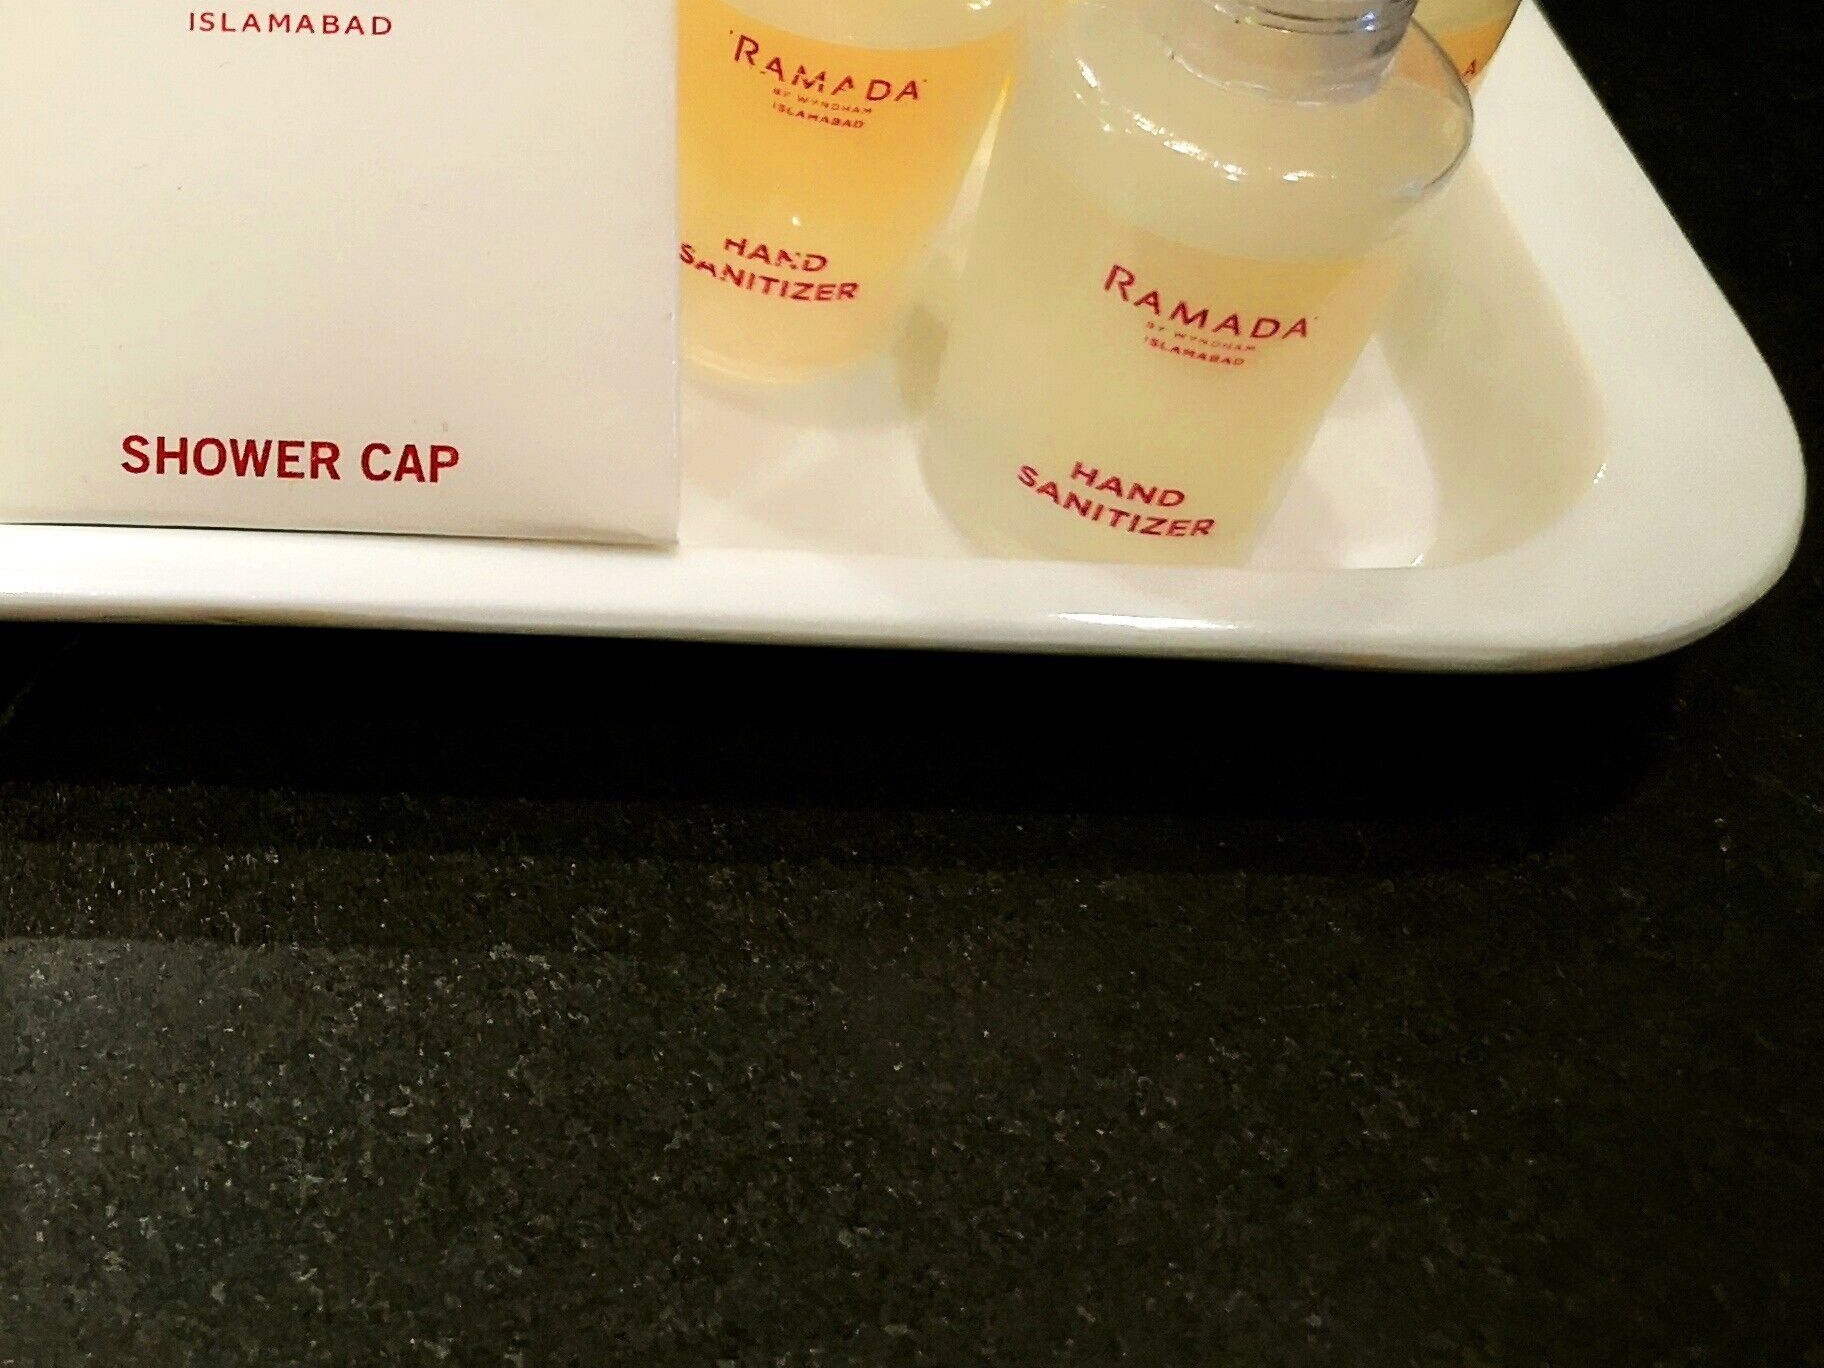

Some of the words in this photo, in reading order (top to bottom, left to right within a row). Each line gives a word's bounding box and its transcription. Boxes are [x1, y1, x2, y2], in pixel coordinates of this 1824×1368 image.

[189, 12, 392, 36] ISLAMABAD
[733, 34, 919, 103] RAMADA
[679, 242, 860, 301] SANITIZER
[723, 238, 829, 272] HAND
[1103, 263, 1309, 340] RAMADA
[121, 434, 341, 480] SHOWER
[360, 442, 460, 484] CAP
[1070, 460, 1186, 507] HAND
[1016, 463, 1216, 537] SANITIZER
